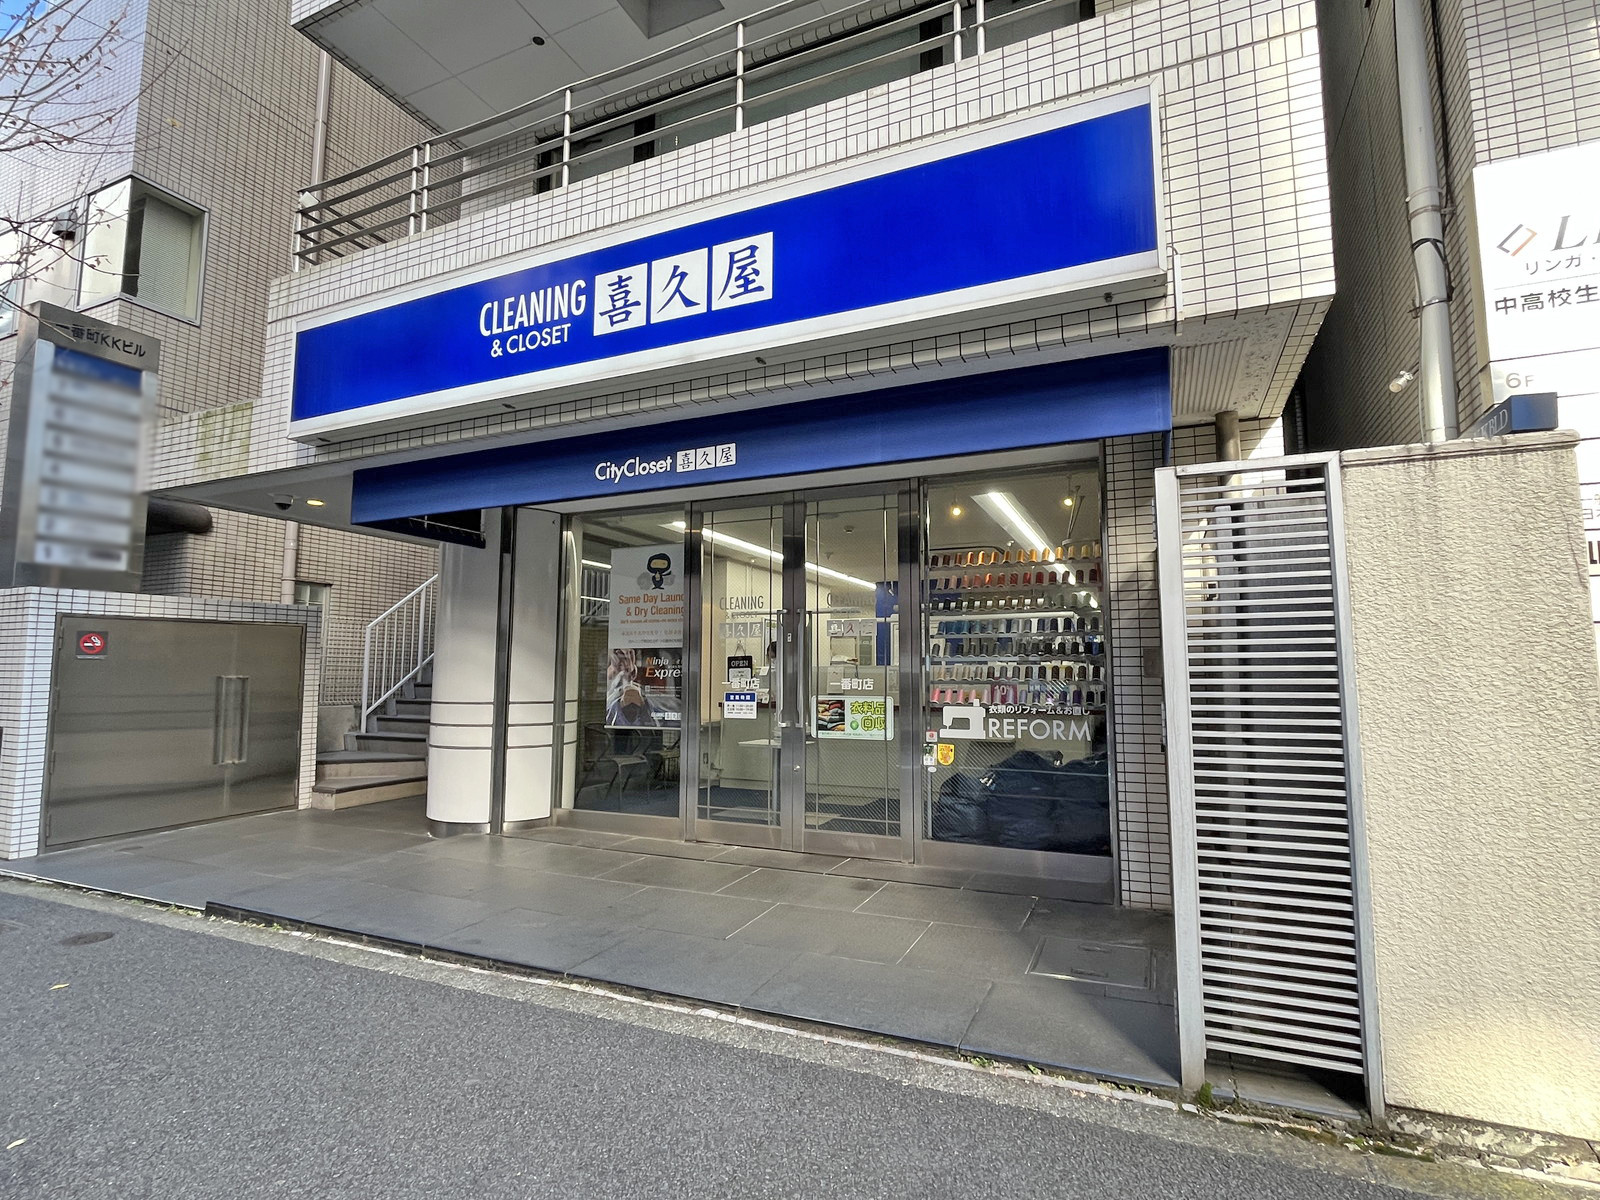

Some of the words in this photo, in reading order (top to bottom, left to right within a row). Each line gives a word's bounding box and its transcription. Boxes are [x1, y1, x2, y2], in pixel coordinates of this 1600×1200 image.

[598, 243, 765, 328] 喜久屋
[480, 279, 587, 336] CLEANING
[55, 323, 146, 357] 一番町KKビル
[490, 338, 504, 358] &
[506, 323, 572, 355] CLOSET
[678, 445, 735, 471] 喜久屋
[595, 456, 673, 484] CityCloset
[618, 595, 641, 605] Same
[643, 593, 659, 605] Day
[720, 596, 764, 611] CLEANING
[625, 606, 632, 616] &
[634, 606, 649, 617] Dry
[645, 656, 669, 667] Ninja
[645, 666, 682, 679] Expre
[830, 678, 874, 690] 一番町店
[988, 718, 1092, 741] REFORM
